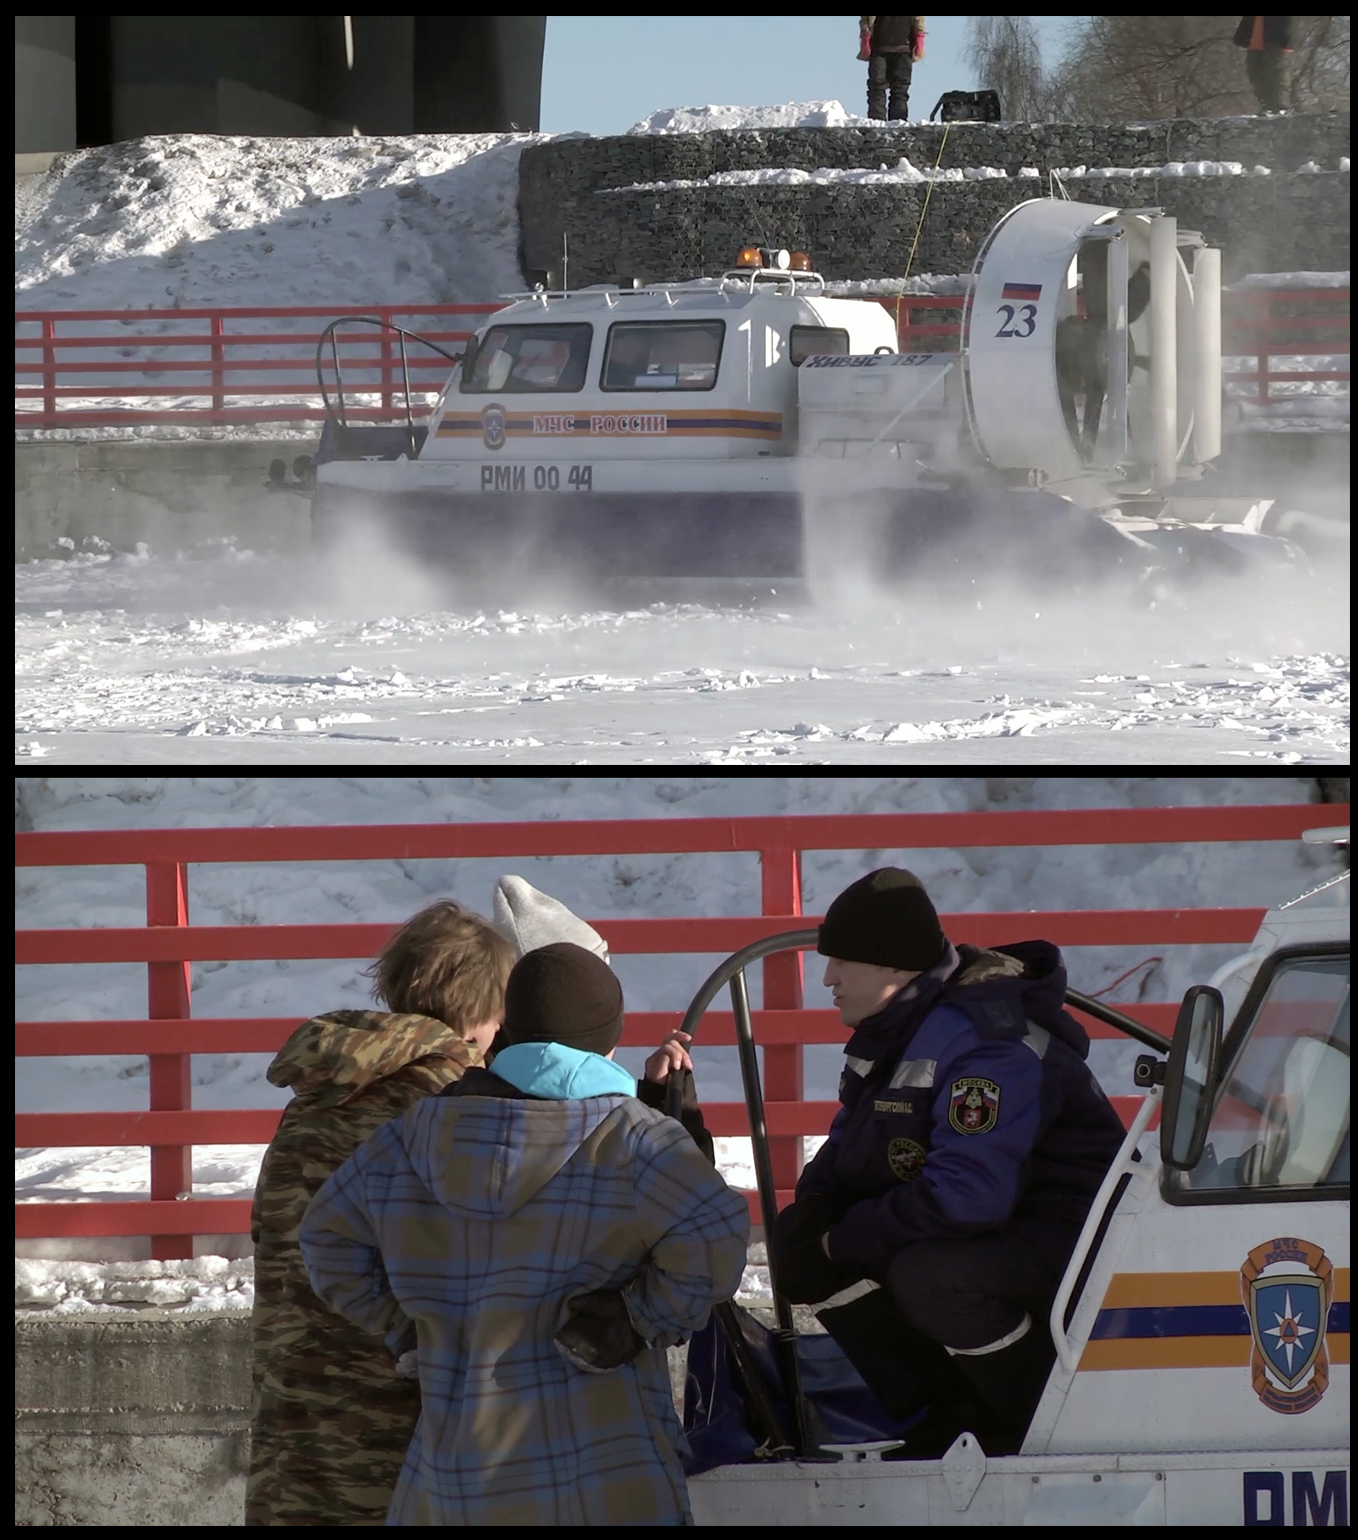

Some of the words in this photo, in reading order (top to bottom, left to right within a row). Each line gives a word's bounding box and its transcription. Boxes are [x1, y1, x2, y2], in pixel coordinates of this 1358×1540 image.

[993, 304, 1038, 338] 23
[806, 355, 882, 368] ХИВУС
[532, 415, 574, 433] МЧС
[590, 414, 667, 433] РОССИИ
[480, 465, 526, 491] РМИ
[533, 465, 560, 491] 00
[568, 465, 593, 491] 44
[1272, 1239, 1300, 1250] МЧС
